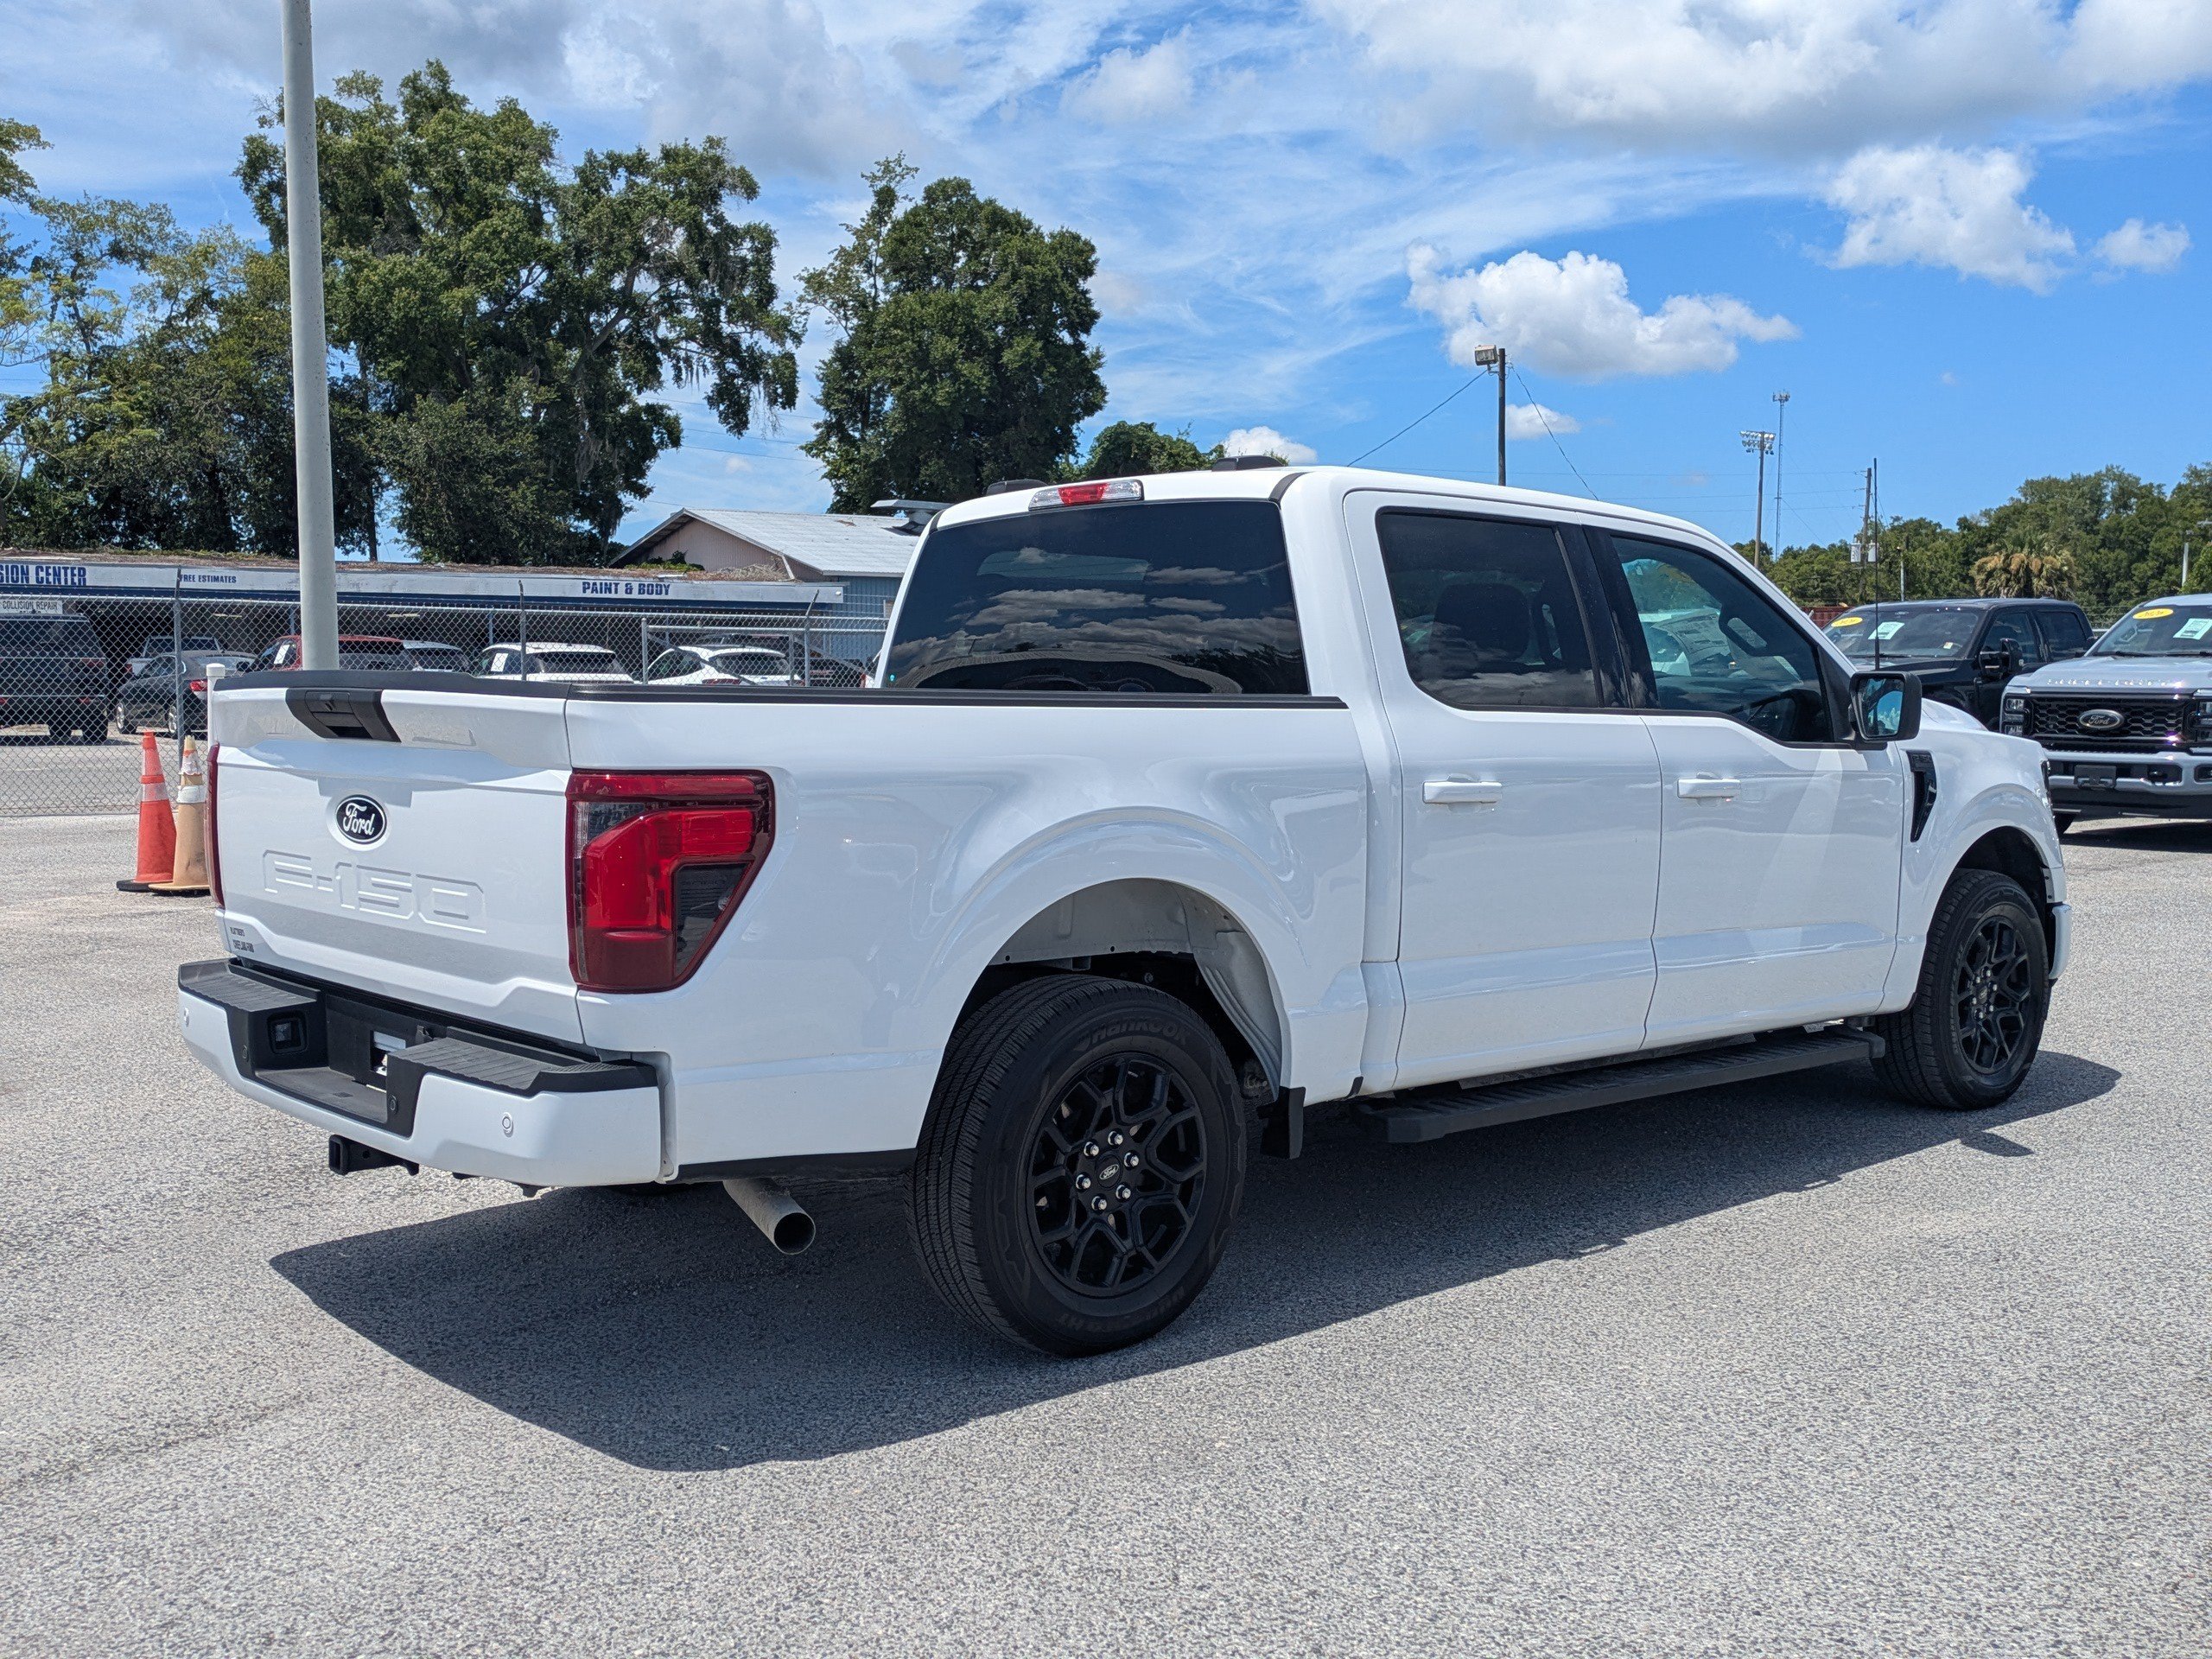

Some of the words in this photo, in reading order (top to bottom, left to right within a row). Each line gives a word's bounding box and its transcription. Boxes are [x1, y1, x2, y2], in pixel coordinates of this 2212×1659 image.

[35, 565, 86, 586] CENTER
[198, 575, 237, 584] ESTIMATES
[582, 582, 620, 594] PAINT
[625, 582, 633, 595] &
[638, 583, 671, 596] BODY
[3, 601, 34, 609] COLLISION
[35, 601, 58, 610] REPAIR
[342, 802, 376, 836] Ford
[262, 849, 488, 934] F-150
